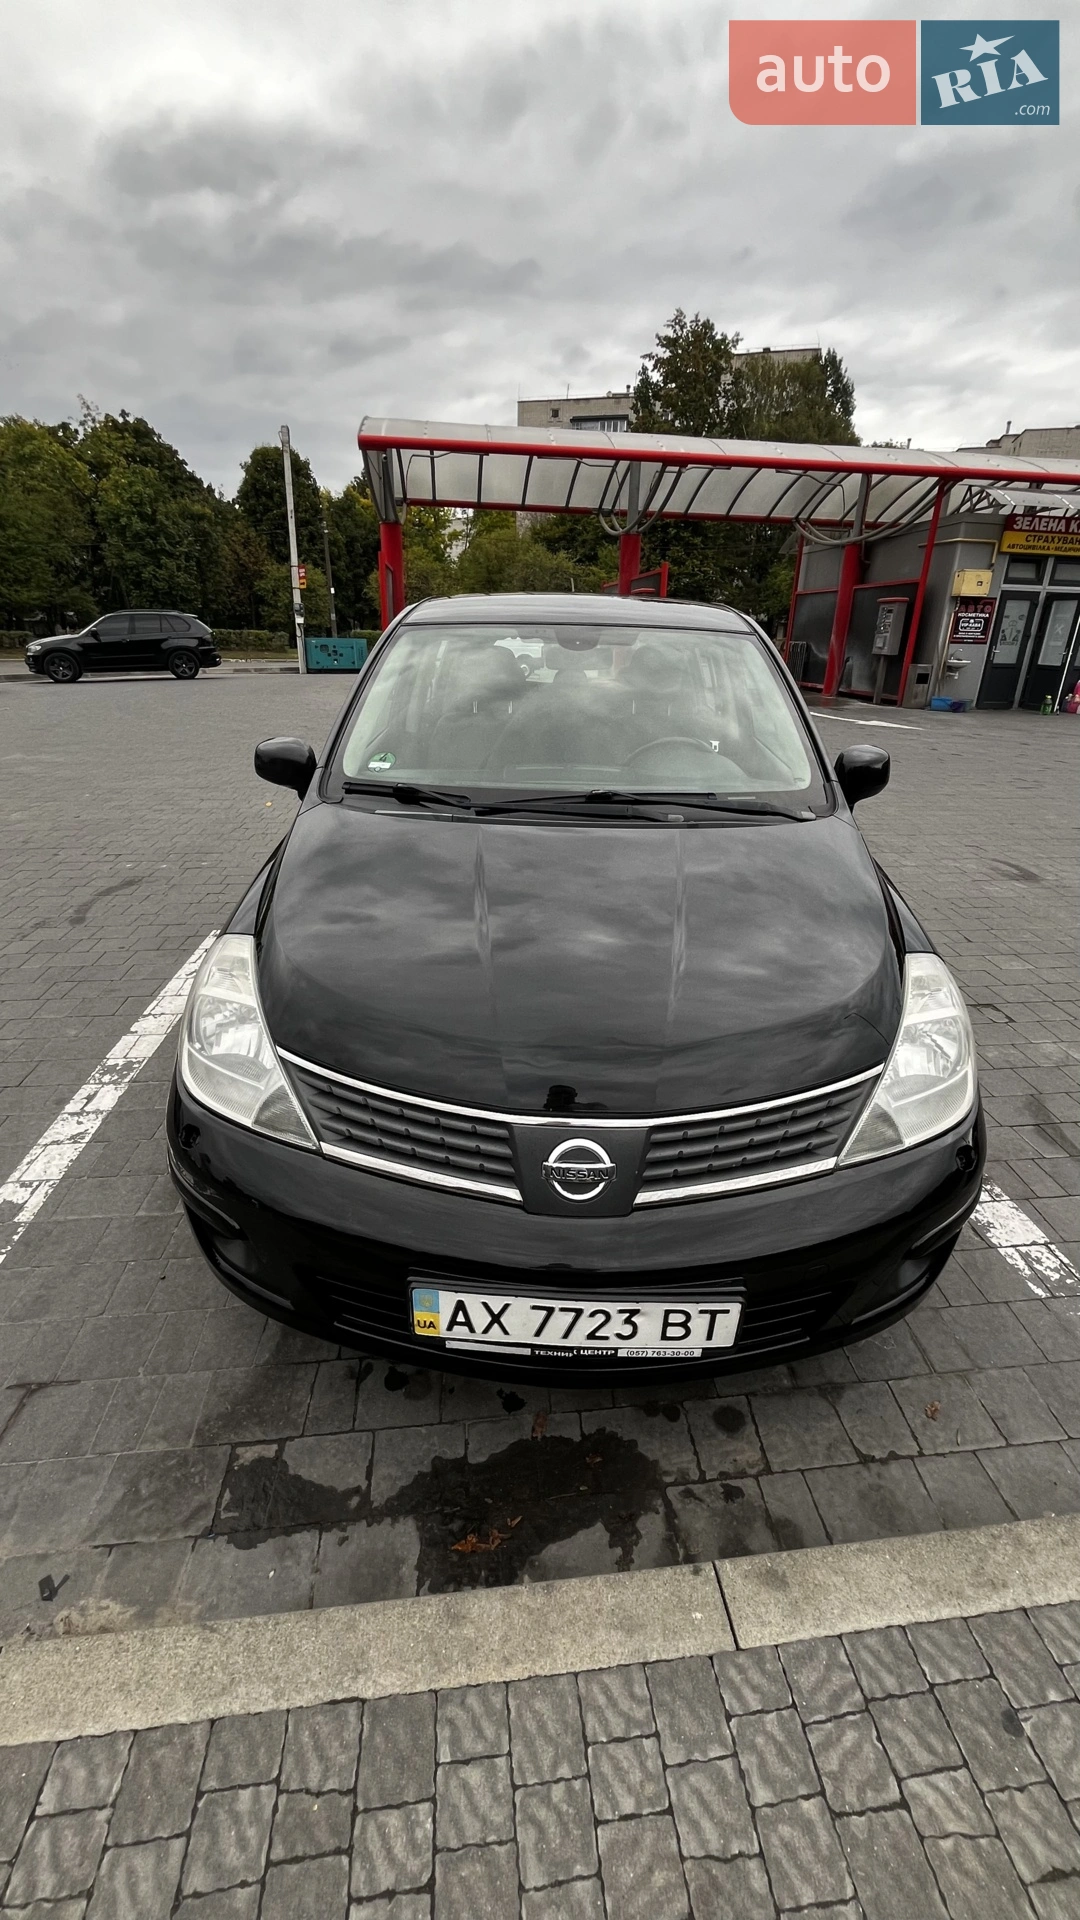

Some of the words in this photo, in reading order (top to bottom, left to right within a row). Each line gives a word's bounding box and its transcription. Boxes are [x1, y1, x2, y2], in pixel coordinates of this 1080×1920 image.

[1012, 515, 1066, 533] ЗЕЛЕНА
[1068, 518, 1080, 534] К
[549, 1167, 609, 1180] NISSAN
[416, 1319, 437, 1330] UA
[445, 1299, 512, 1336] AX
[529, 1304, 641, 1341] 7723
[659, 1308, 731, 1341] BT
[626, 1349, 649, 1358] (057)
